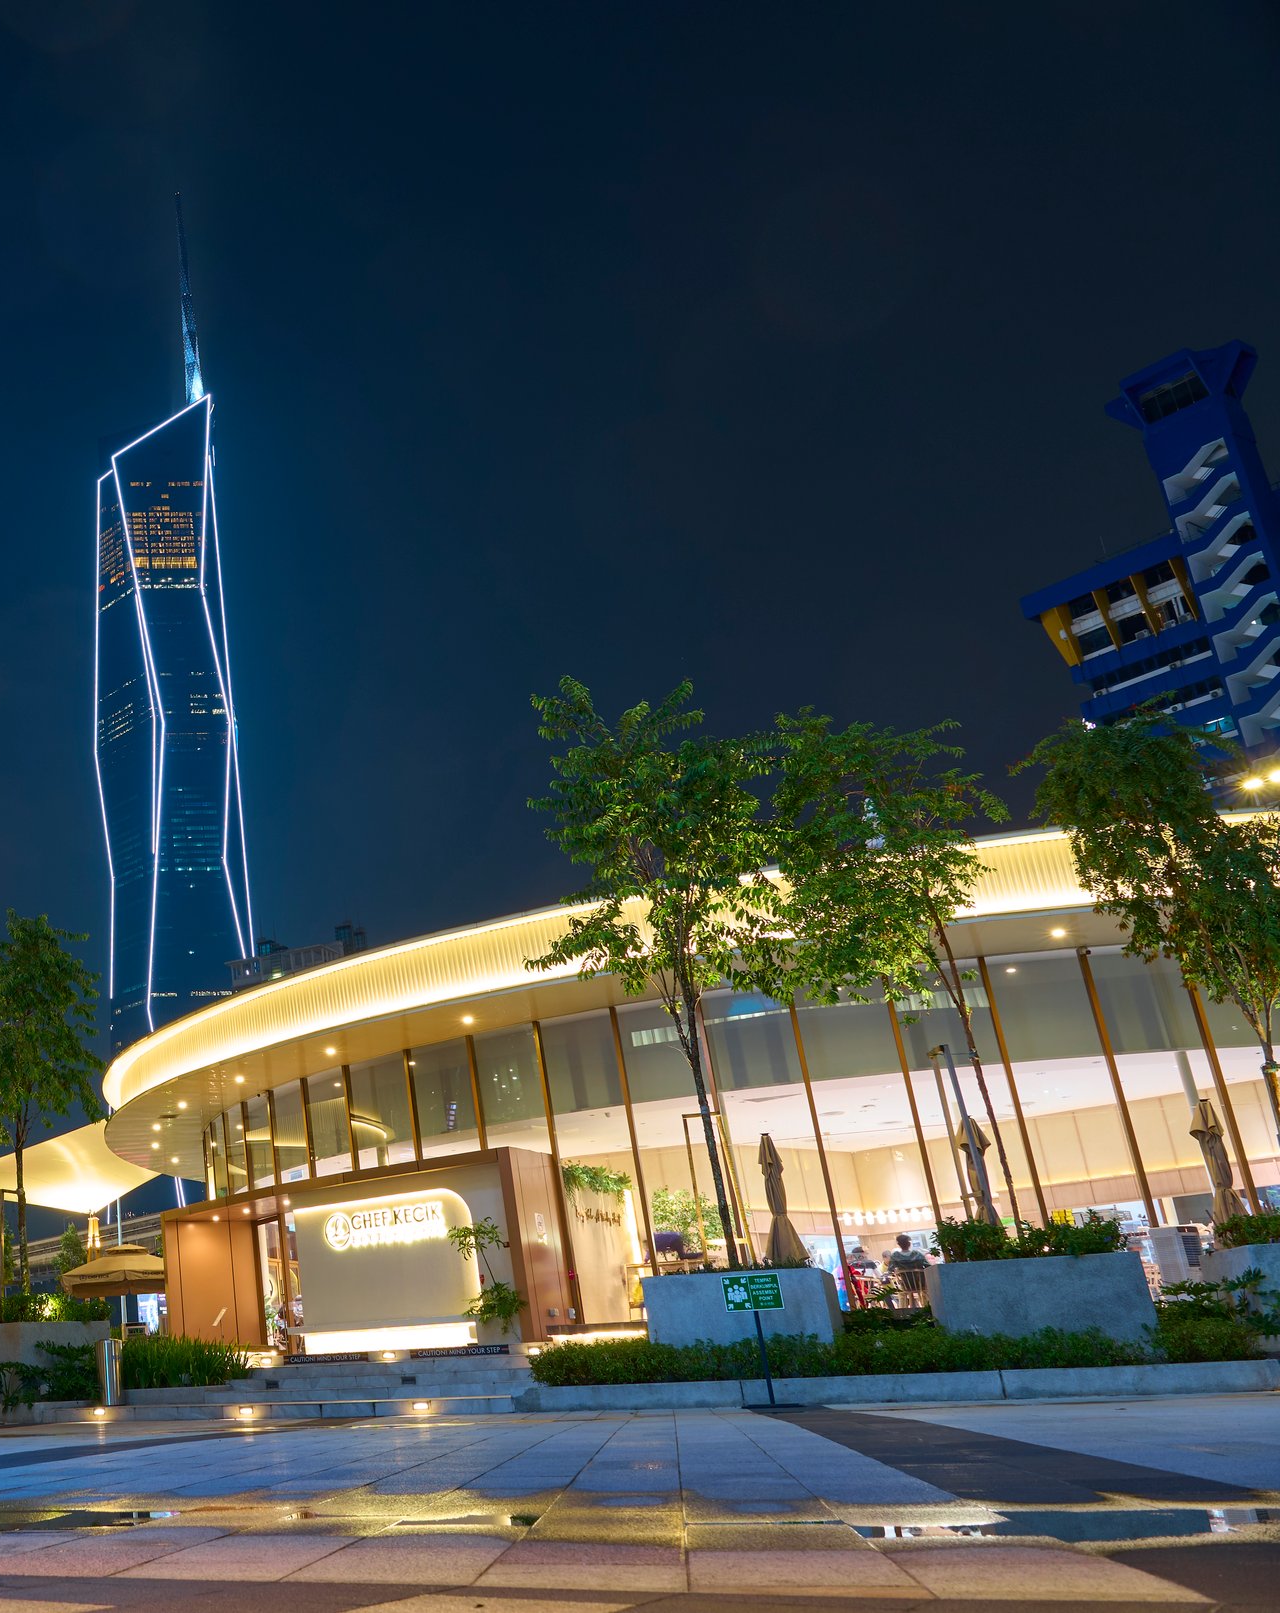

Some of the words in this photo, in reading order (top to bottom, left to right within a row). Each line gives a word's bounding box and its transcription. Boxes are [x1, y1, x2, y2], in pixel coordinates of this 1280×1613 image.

[350, 1211, 388, 1230] CHEF
[392, 1205, 441, 1226] KECIK
[467, 1347, 485, 1355] YOUR
[486, 1346, 501, 1354] STEP
